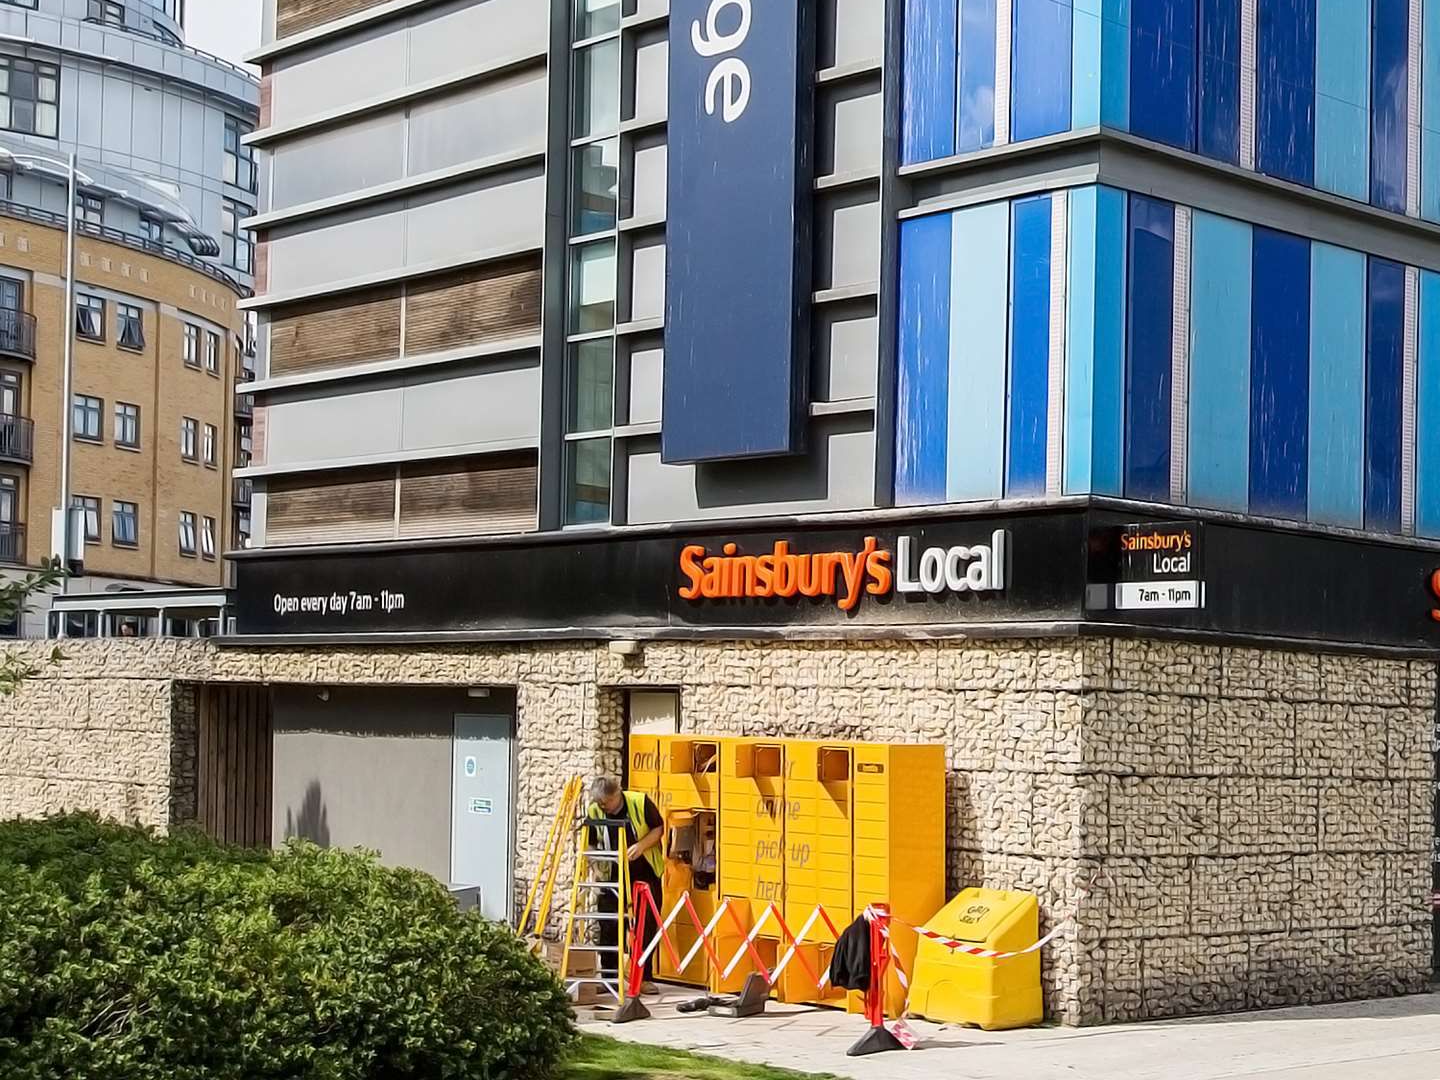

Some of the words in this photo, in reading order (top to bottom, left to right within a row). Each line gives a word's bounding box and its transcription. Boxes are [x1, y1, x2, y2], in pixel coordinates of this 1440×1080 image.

[1120, 529, 1192, 552] Sainsbury's
[678, 535, 893, 611] Sainsbury's
[896, 529, 1006, 593] Local
[1153, 551, 1191, 573] Local
[273, 593, 299, 616] Open
[300, 596, 328, 615] every
[329, 591, 348, 615] day
[349, 591, 372, 610] 7am
[380, 589, 405, 614] 11pm
[1138, 588, 1160, 602] 7am
[1168, 588, 1191, 603] 11pm
[791, 841, 811, 869] up
